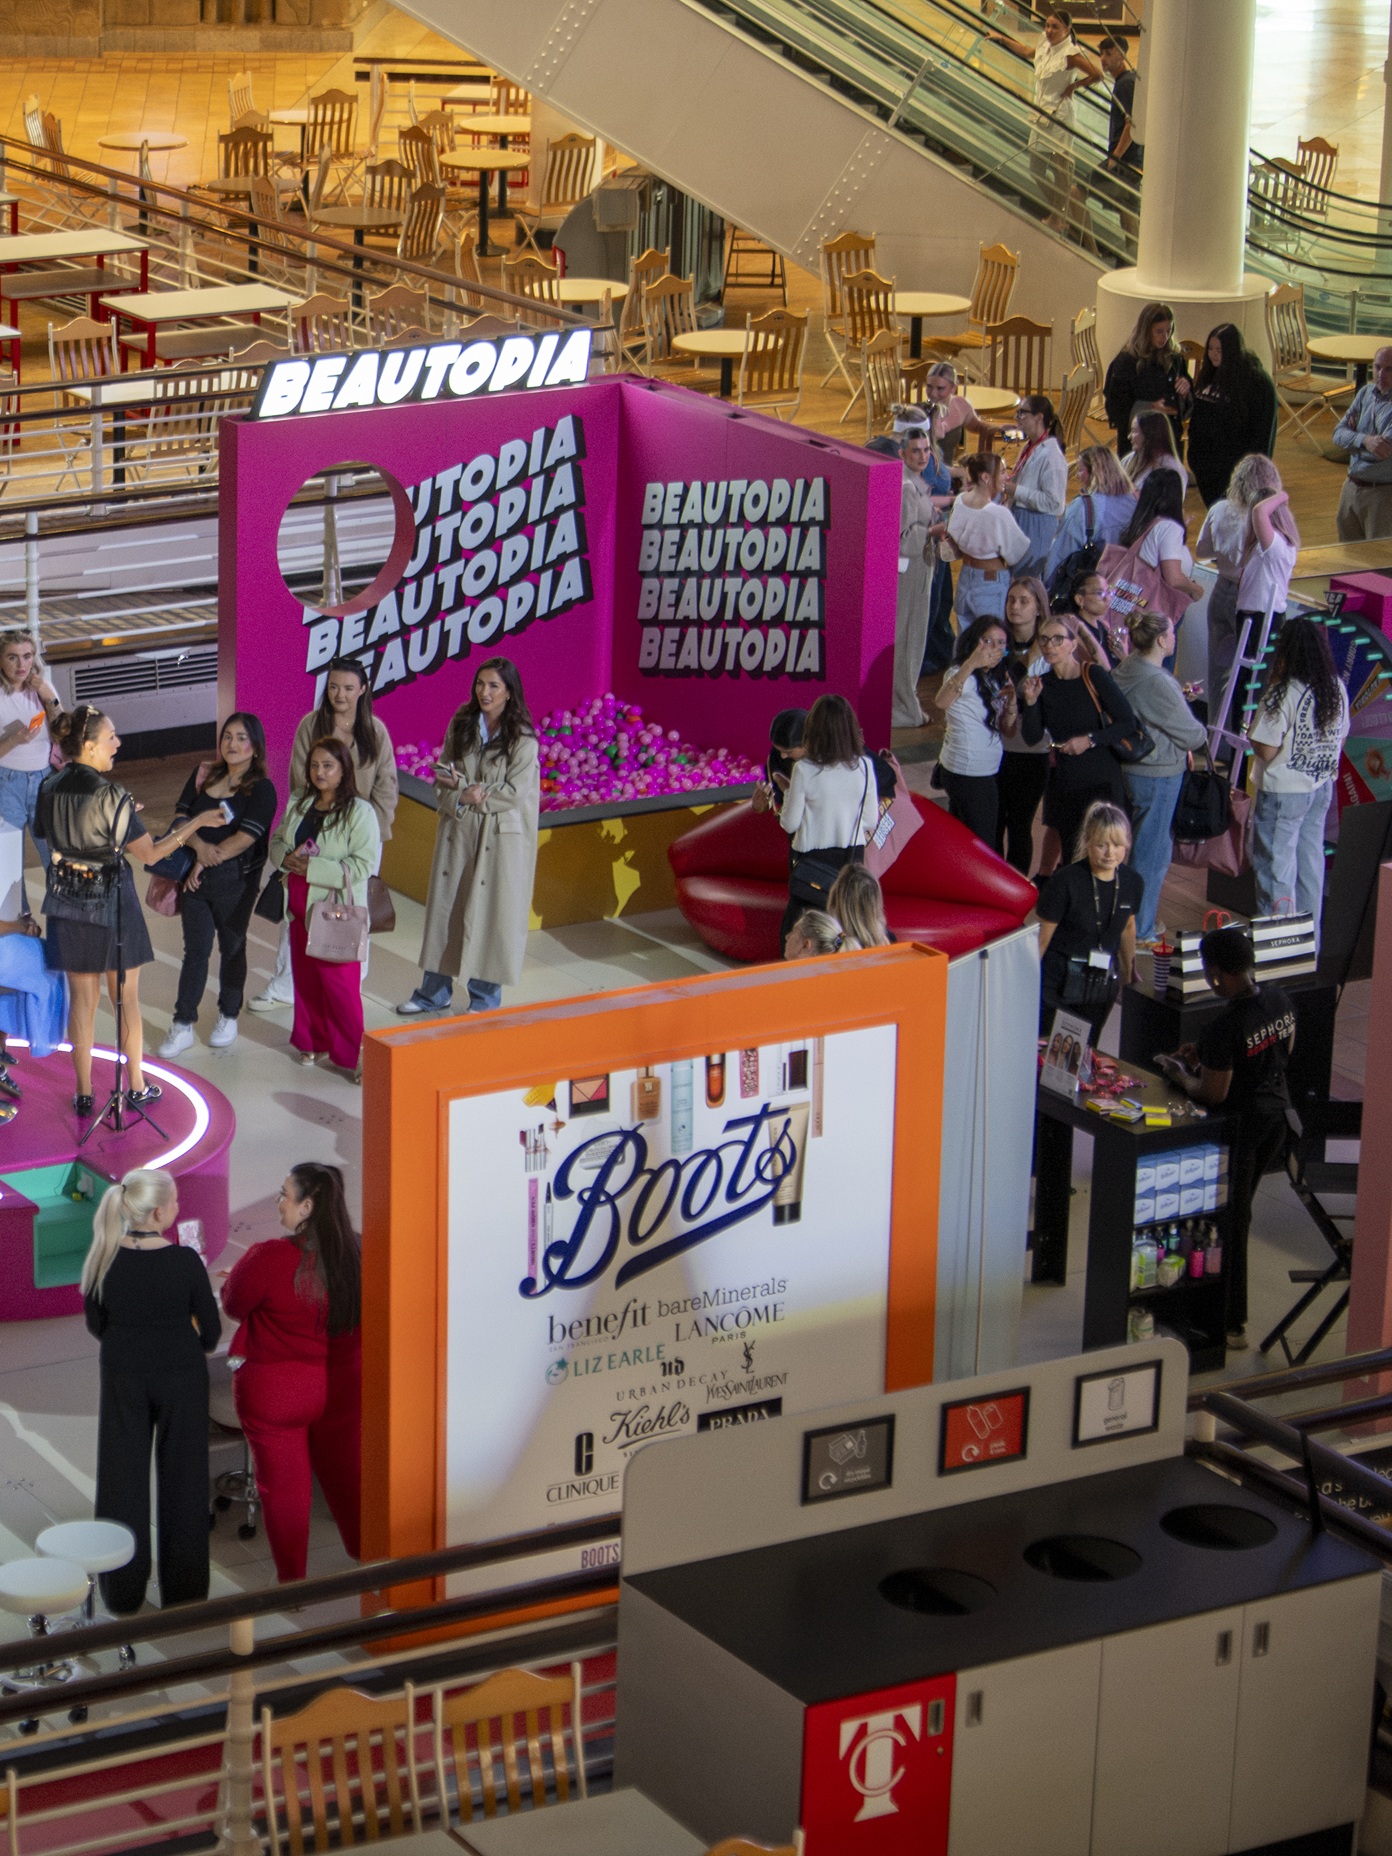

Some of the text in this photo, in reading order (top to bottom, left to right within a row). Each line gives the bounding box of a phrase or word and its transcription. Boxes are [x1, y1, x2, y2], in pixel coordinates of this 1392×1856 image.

[259, 330, 592, 418] BEAUTOPIA
[405, 414, 577, 527] UTOPIA
[641, 477, 825, 525] BEAUTOPIA
[638, 526, 821, 573] BEAUTOPIA
[637, 577, 820, 622] BEAUTOPIA
[638, 627, 820, 673] BEAUTOPIA
[1300, 694, 1314, 723] FRESH
[1271, 937, 1300, 947] SEPHORA
[1246, 1011, 1296, 1049] SEPHORA
[519, 1102, 798, 1299] Boots
[547, 1277, 787, 1345] benefit bareMinerals
[674, 1301, 786, 1343] LANCÔME
[711, 1331, 747, 1344] PARIS
[573, 1344, 666, 1377] LIZ EARLE
[616, 1370, 729, 1402] URBAN DECAY
[602, 1401, 690, 1444] Kiehl's
[546, 1473, 619, 1503] CLINIQUE
[580, 1543, 620, 1569] BOOTS
